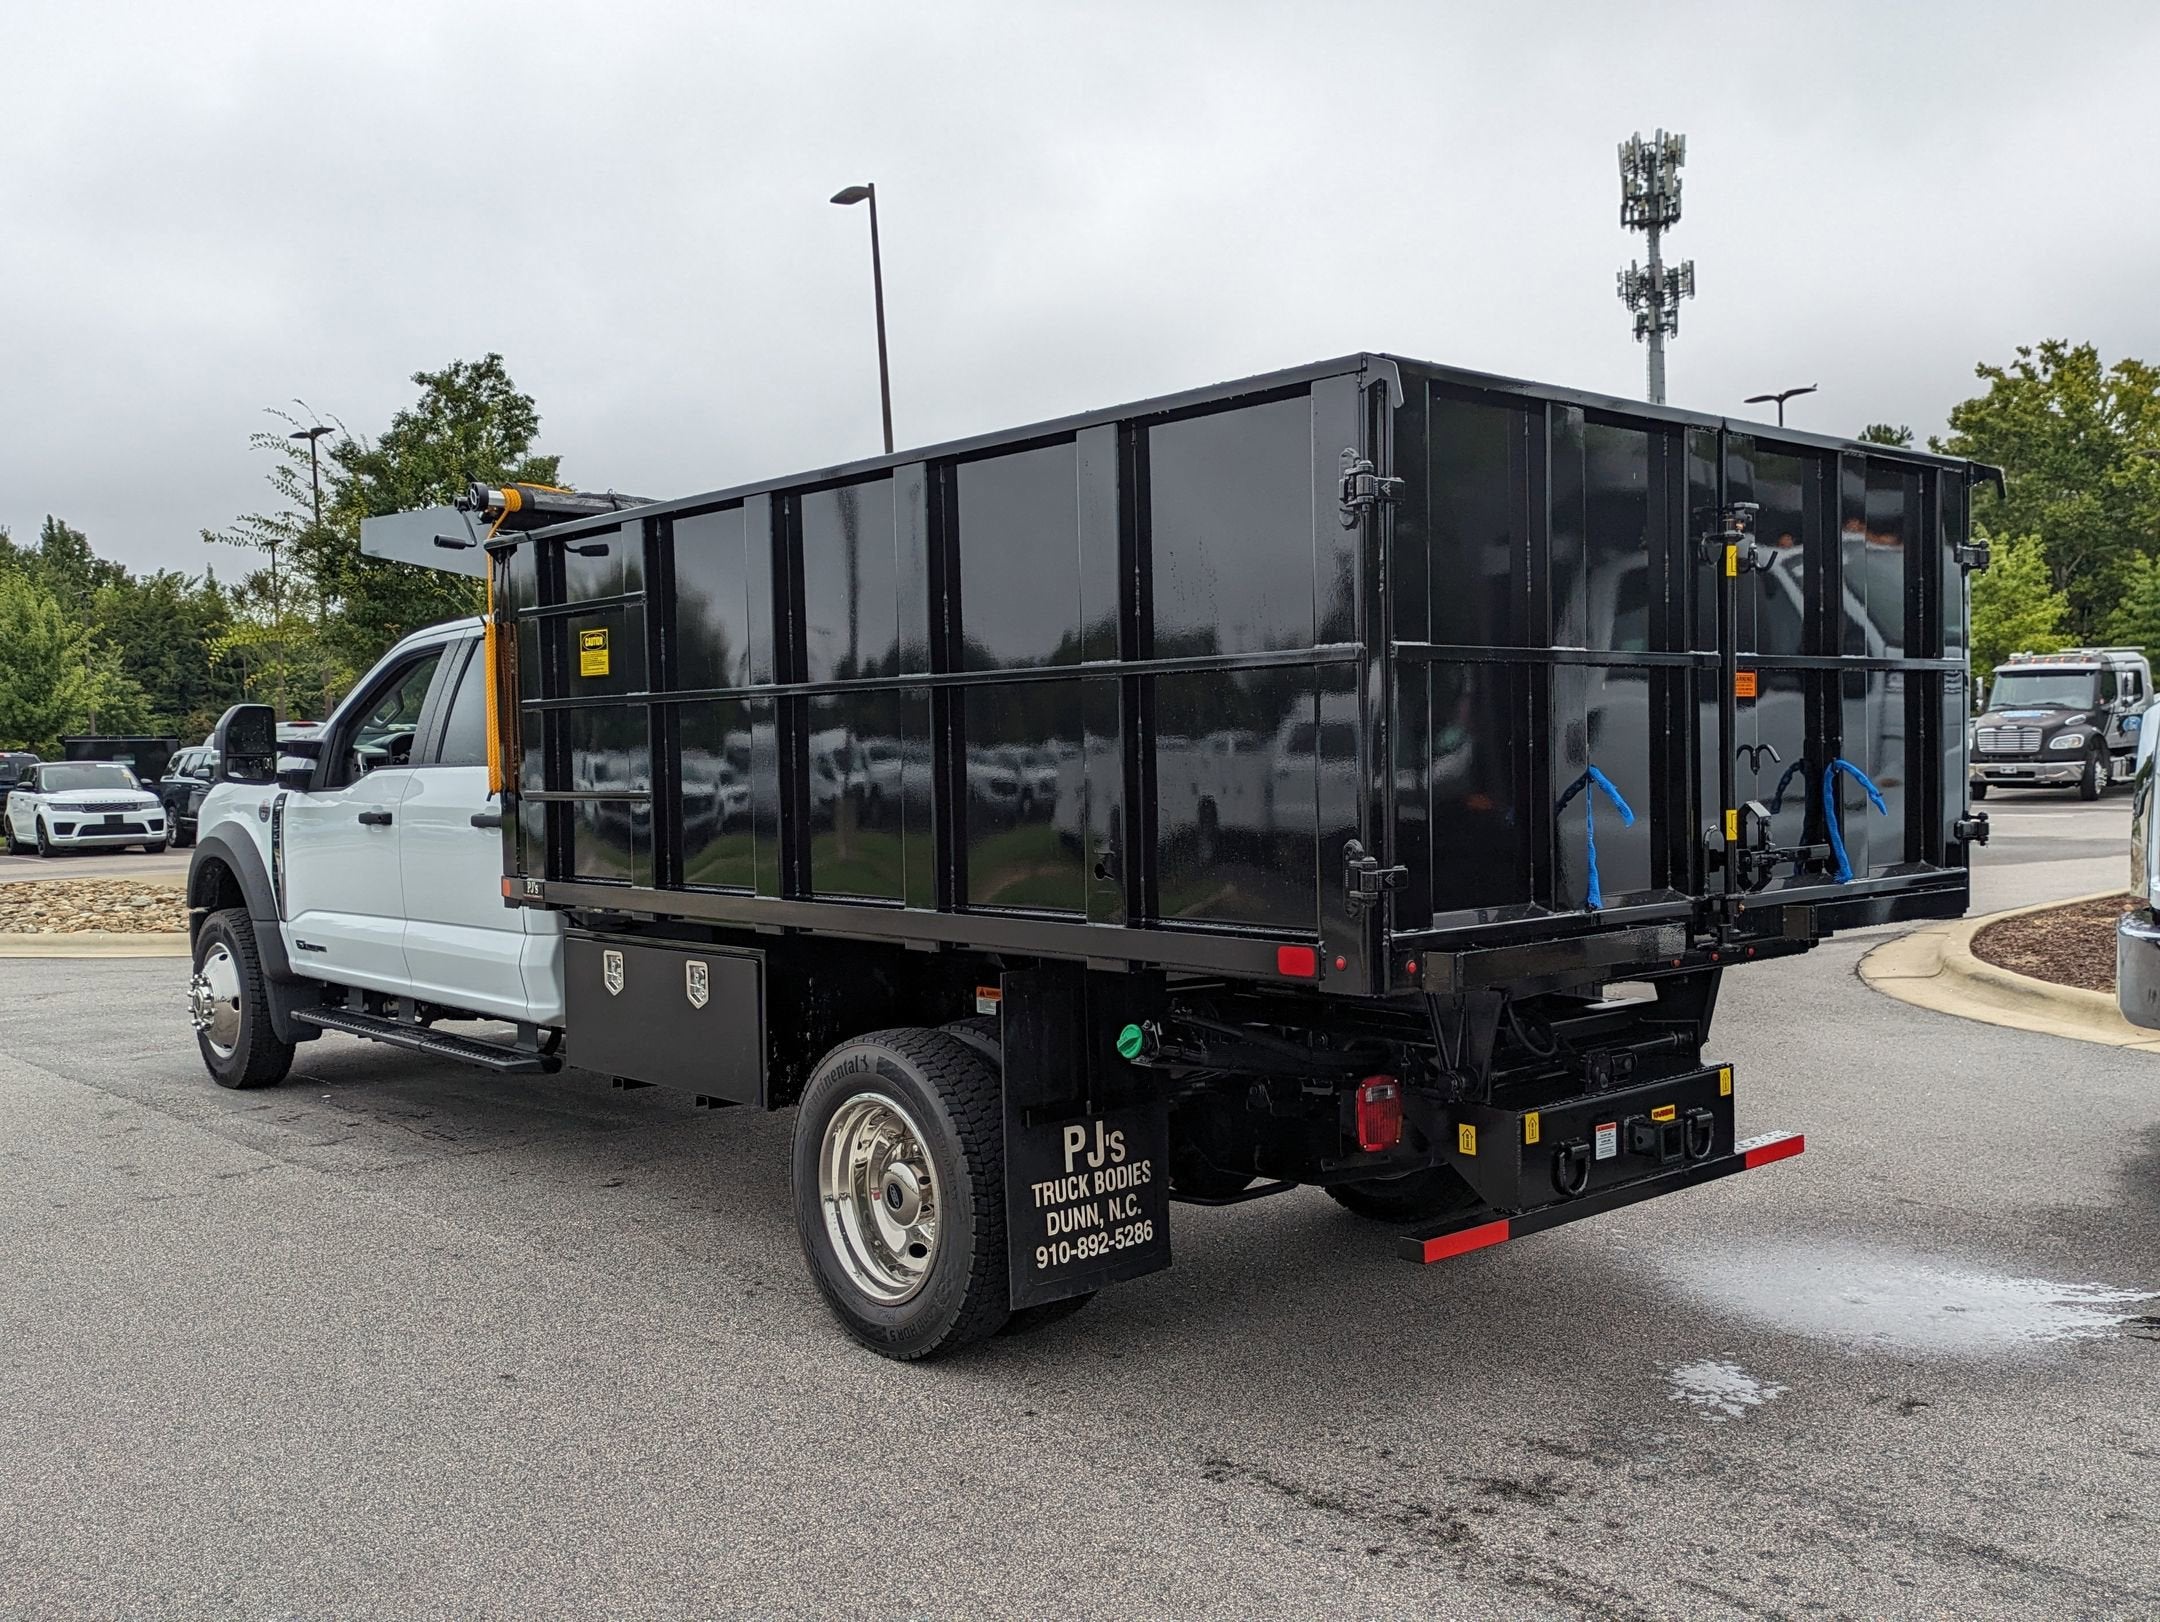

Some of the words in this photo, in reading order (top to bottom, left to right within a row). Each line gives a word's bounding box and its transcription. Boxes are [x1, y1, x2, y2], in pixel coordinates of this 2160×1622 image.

[527, 881, 539, 894] PJ's
[1031, 1173, 1090, 1208] TRUCK
[1094, 1159, 1151, 1195] BODIES
[1046, 1202, 1104, 1236] DUNN,
[1108, 1193, 1142, 1222] N.C.
[1036, 1219, 1153, 1269] 910-892-5286
